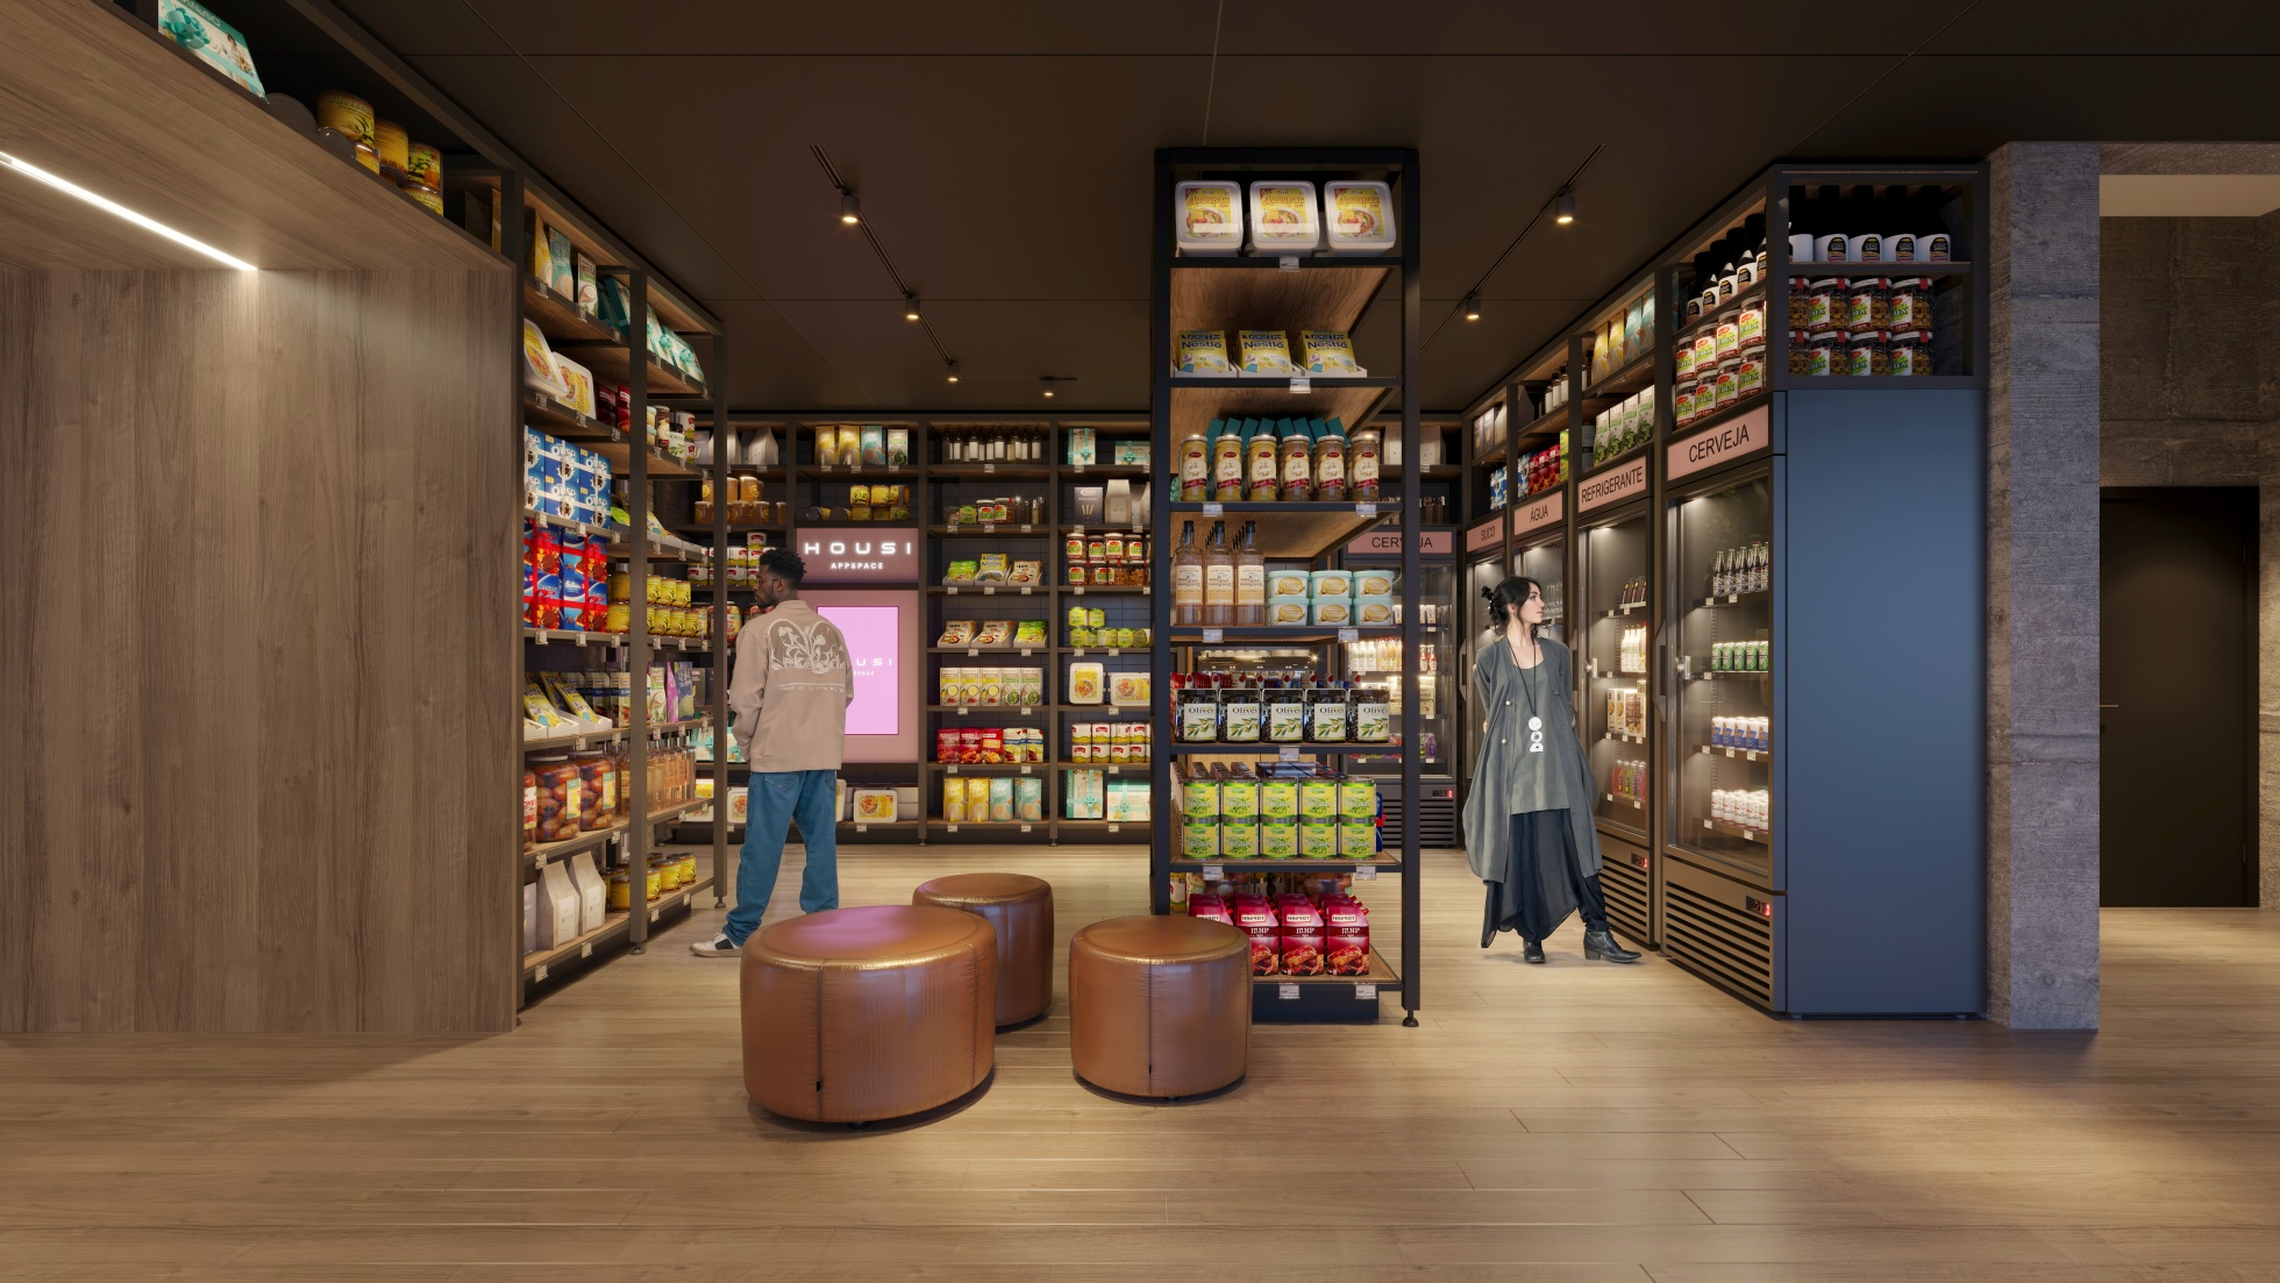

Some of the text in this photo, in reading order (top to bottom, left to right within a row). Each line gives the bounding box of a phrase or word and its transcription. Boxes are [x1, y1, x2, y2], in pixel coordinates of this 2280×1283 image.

[1688, 424, 1750, 463] CERVEJA
[1581, 466, 1643, 503] REFRIGERANTE
[1529, 504, 1549, 524] ÁGUA
[1480, 525, 1495, 541] SUCO
[804, 542, 911, 555] HOUSI
[1371, 537, 1433, 548] CERJA
[830, 562, 884, 570] APPSPACE
